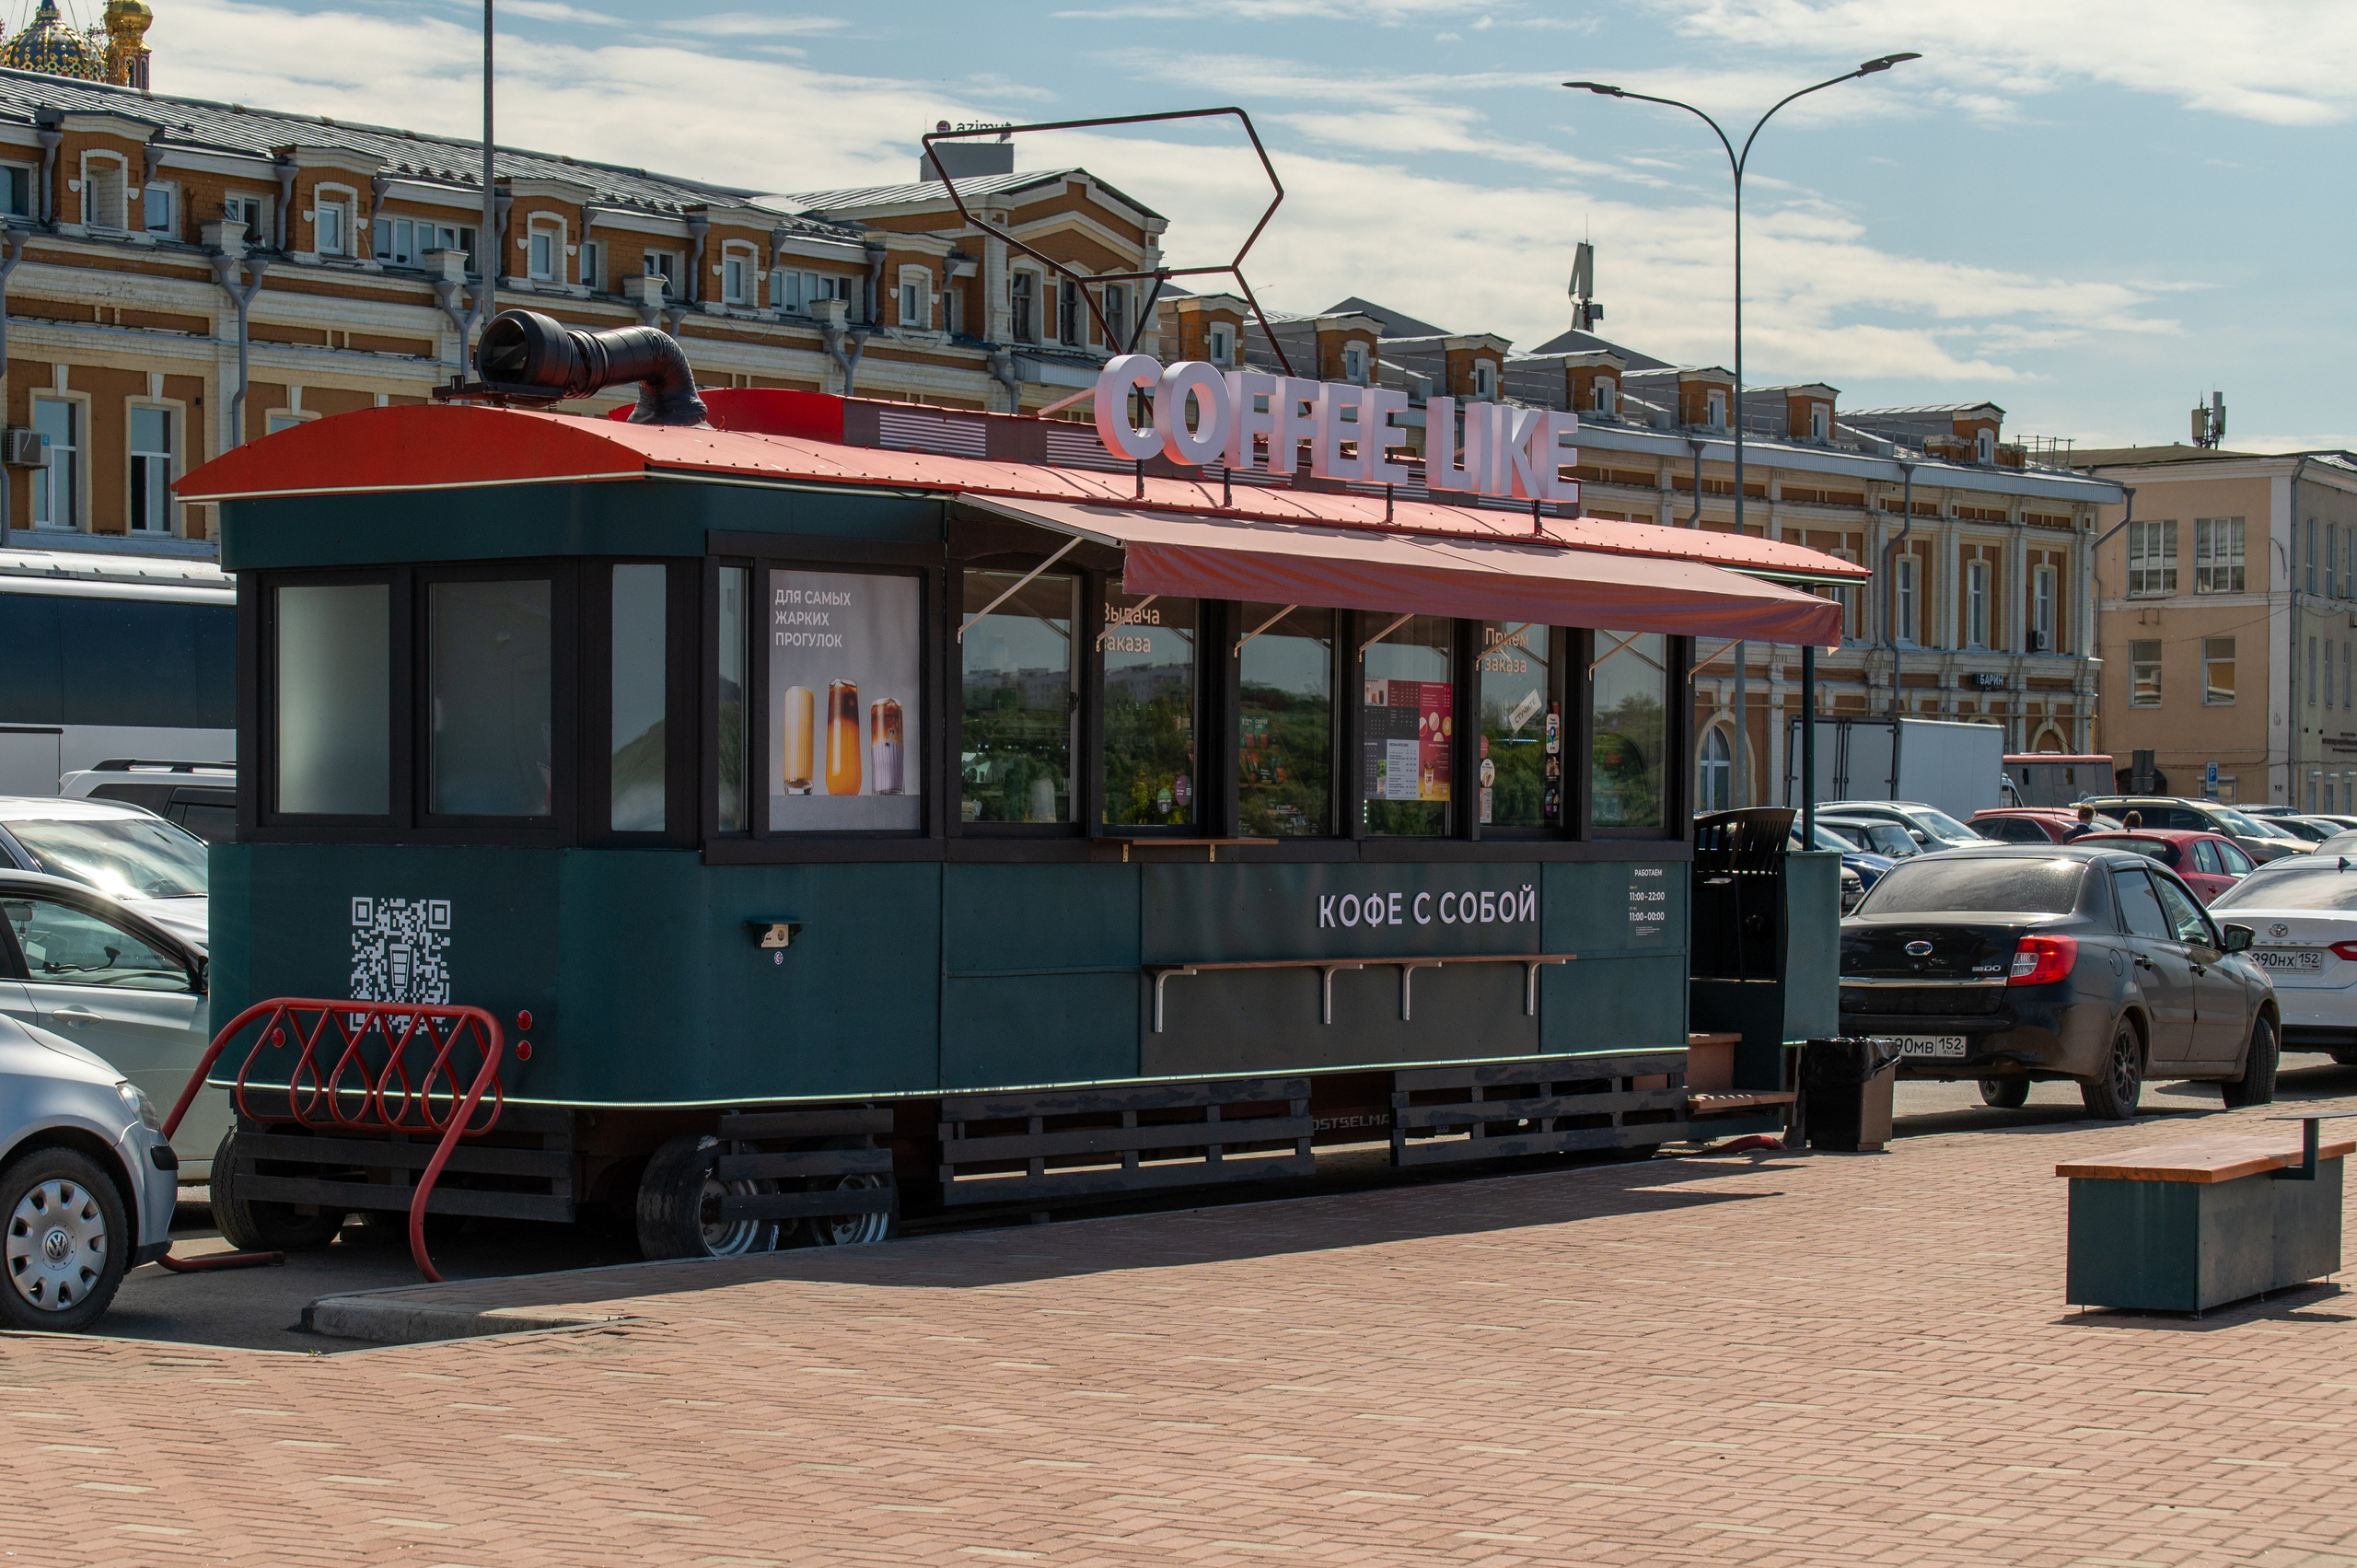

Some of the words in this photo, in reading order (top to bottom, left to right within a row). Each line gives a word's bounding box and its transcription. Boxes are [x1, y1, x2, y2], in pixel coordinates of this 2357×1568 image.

[1094, 354, 1408, 486] COFFEE
[1426, 396, 1578, 504] LIKE
[775, 589, 801, 606] ДЛЯ
[805, 590, 851, 606] САМЫХ
[775, 610, 830, 626] ЖАРКИХ
[775, 632, 842, 647] ПРОГУЛОК
[1105, 635, 1151, 653] аказа
[1484, 657, 1527, 673] заказа
[1980, 674, 2003, 685] БАРИН
[1514, 698, 1537, 724] СТУЧИТЕ
[1318, 892, 1403, 928] КОФЕ
[1412, 891, 1432, 925] С
[1438, 884, 1536, 924] СОБОЙ
[2298, 953, 2318, 964] 152
[1885, 1038, 1934, 1054] 90МВ
[1938, 1037, 1962, 1050] 152
